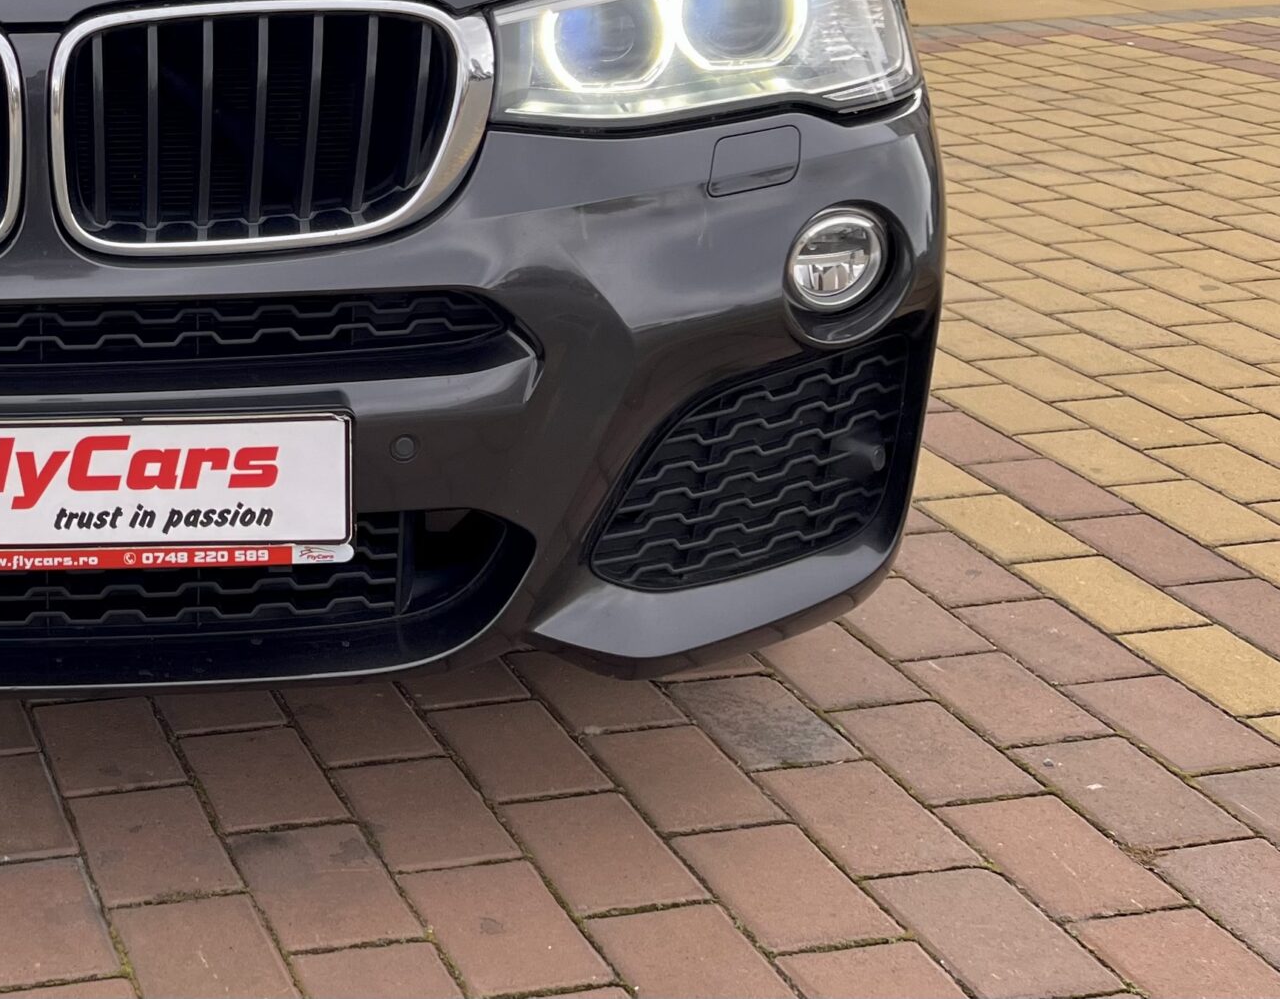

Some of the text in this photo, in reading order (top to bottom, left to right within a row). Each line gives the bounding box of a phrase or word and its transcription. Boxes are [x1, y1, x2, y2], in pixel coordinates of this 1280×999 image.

[54, 502, 275, 534] trust in passion
[141, 552, 188, 564] 0748
[194, 551, 228, 563] 220
[234, 549, 269, 562] 589
